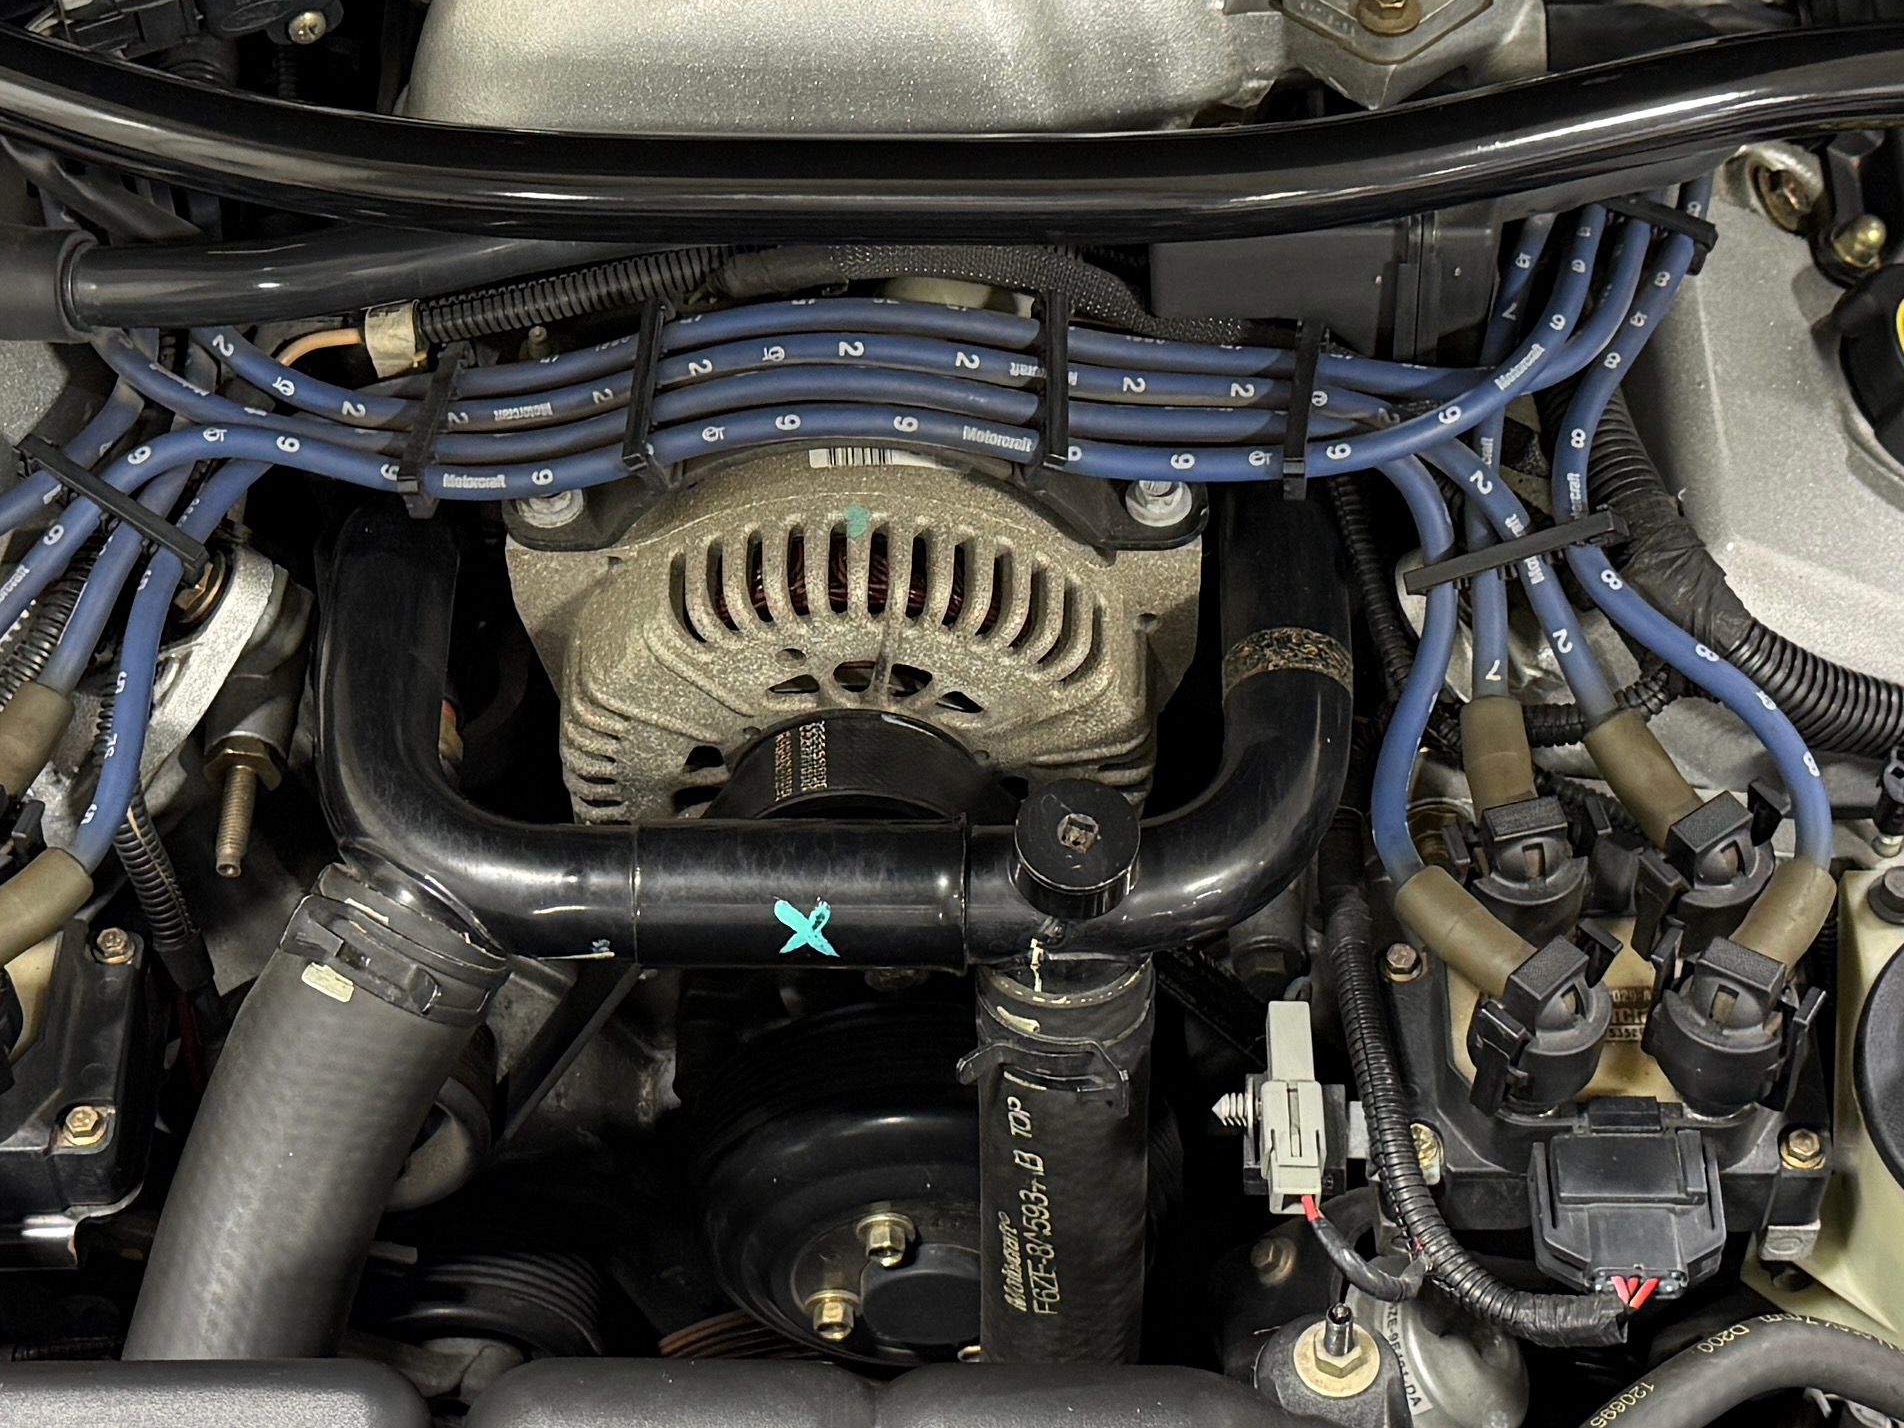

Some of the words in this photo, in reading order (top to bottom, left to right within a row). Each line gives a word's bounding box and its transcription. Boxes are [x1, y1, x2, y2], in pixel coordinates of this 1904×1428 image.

[1493, 344, 1547, 391] Motorcraft
[962, 424, 1034, 454] Motorcraft
[442, 472, 507, 490] Motorcraft
[1007, 1095, 1033, 1138] TOP
